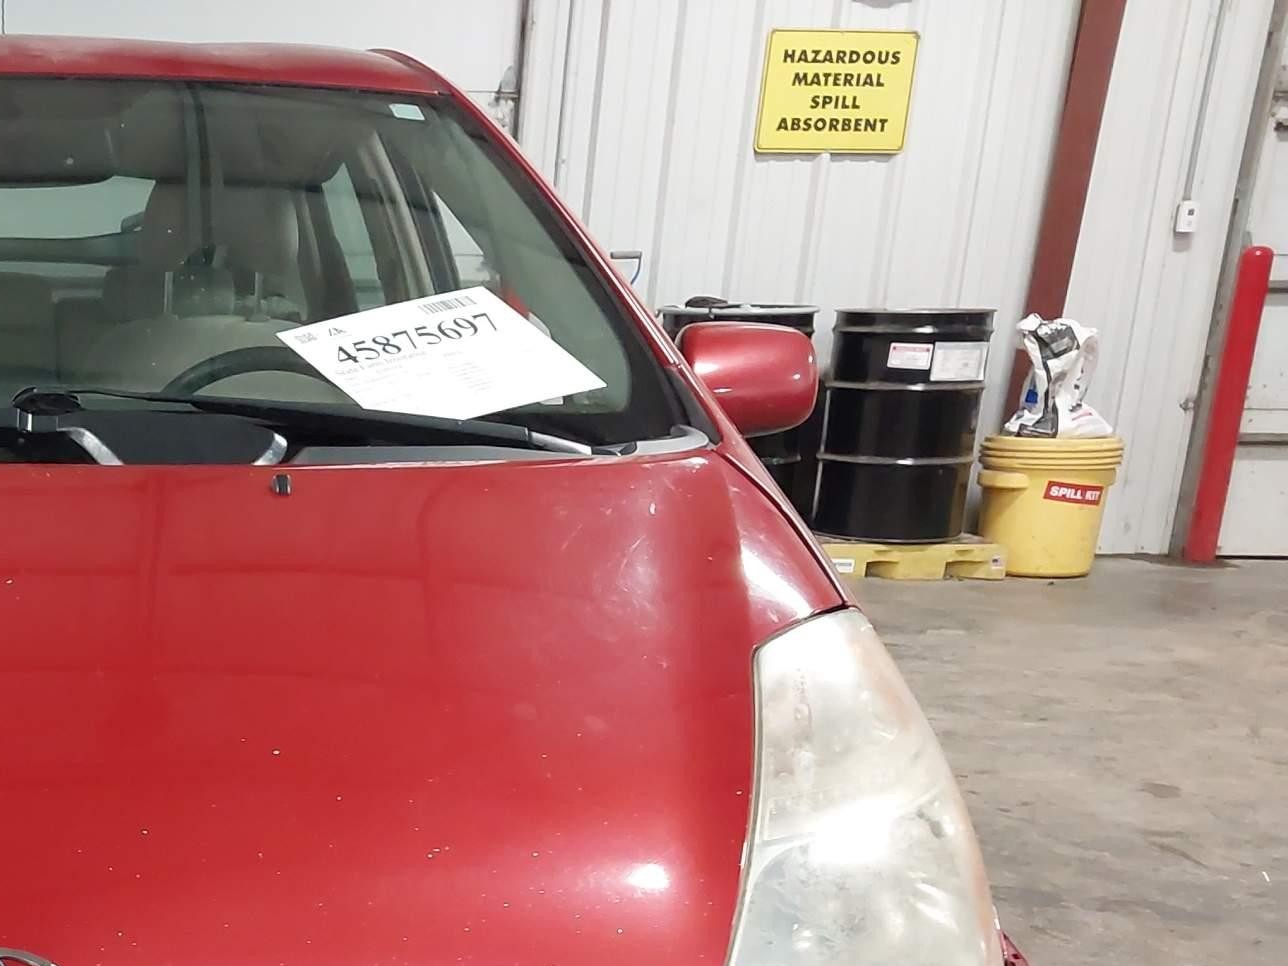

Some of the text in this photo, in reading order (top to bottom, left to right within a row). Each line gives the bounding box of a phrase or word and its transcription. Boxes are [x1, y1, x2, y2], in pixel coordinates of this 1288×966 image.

[782, 49, 901, 65] HAZARDOUS
[791, 72, 885, 87] MATERIAL
[809, 95, 861, 110] SPILL
[775, 117, 889, 133] ABSORBENT
[336, 312, 499, 363] 45875697
[1049, 485, 1101, 501] SPILL KIT
